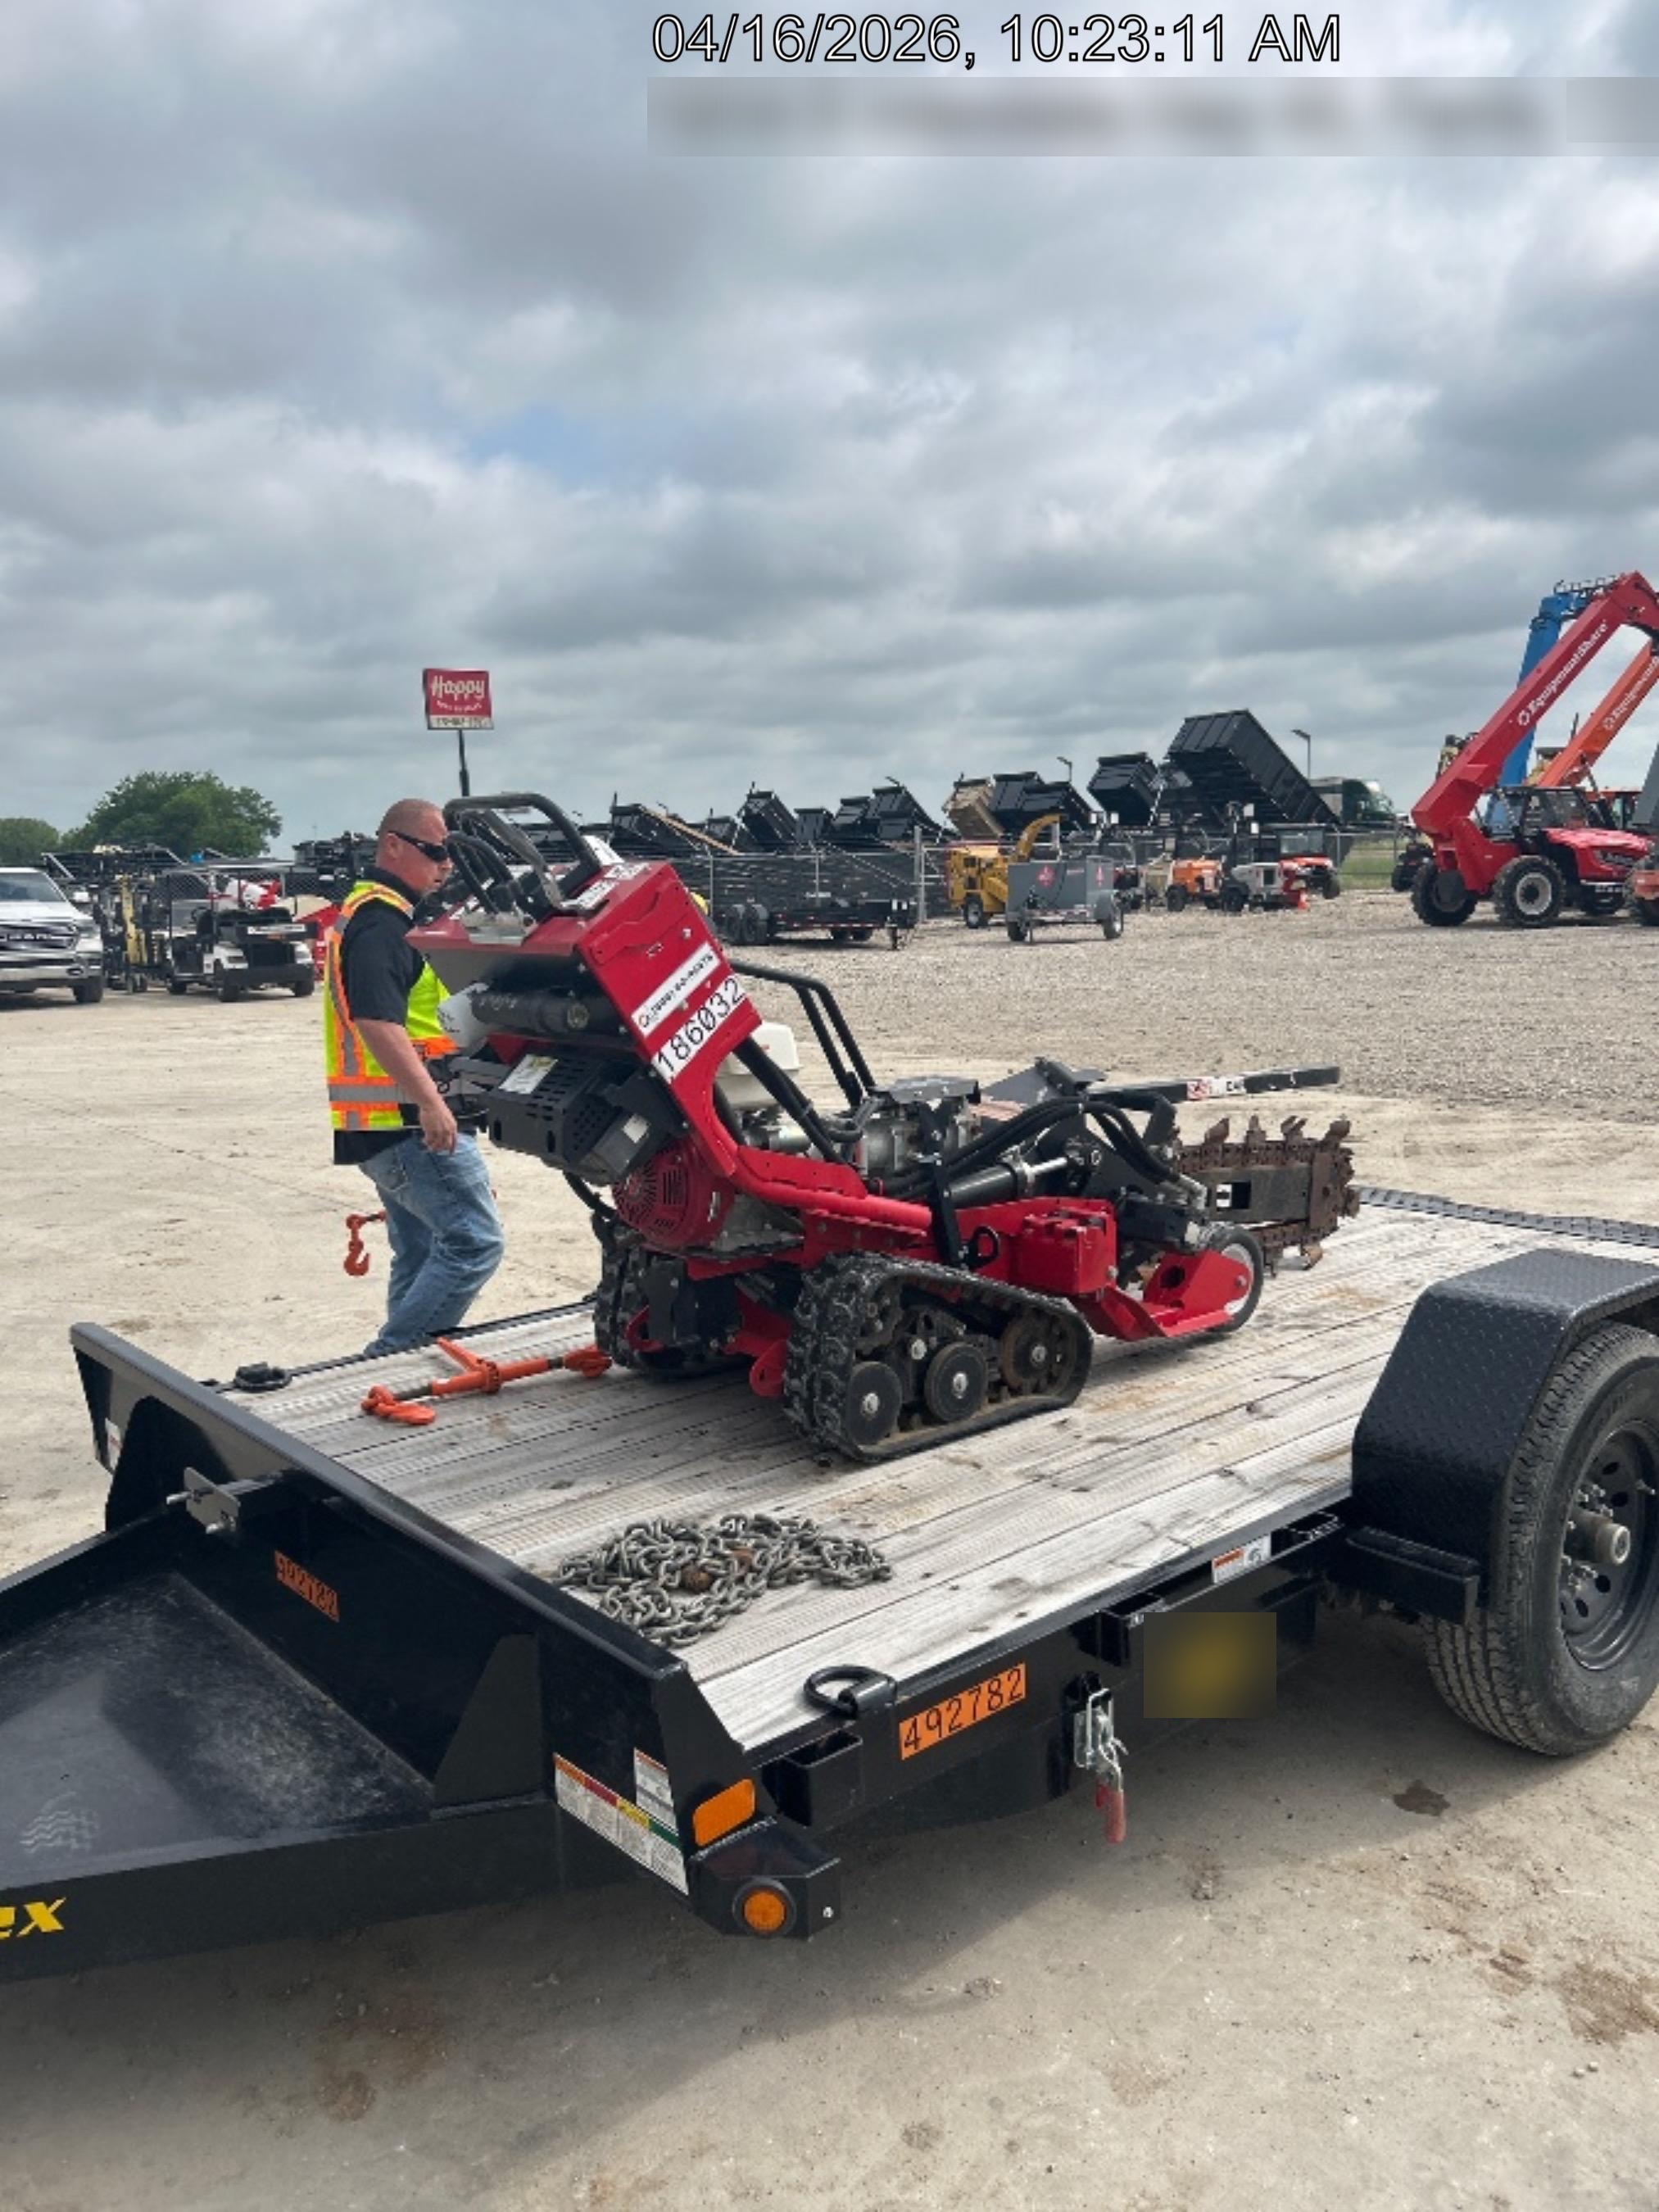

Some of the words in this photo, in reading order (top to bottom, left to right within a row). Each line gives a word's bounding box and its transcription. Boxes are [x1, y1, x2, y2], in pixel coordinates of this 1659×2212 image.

[432, 674, 485, 701] Happy
[658, 977, 746, 1072] 186032
[904, 1668, 1022, 1750] 492782
